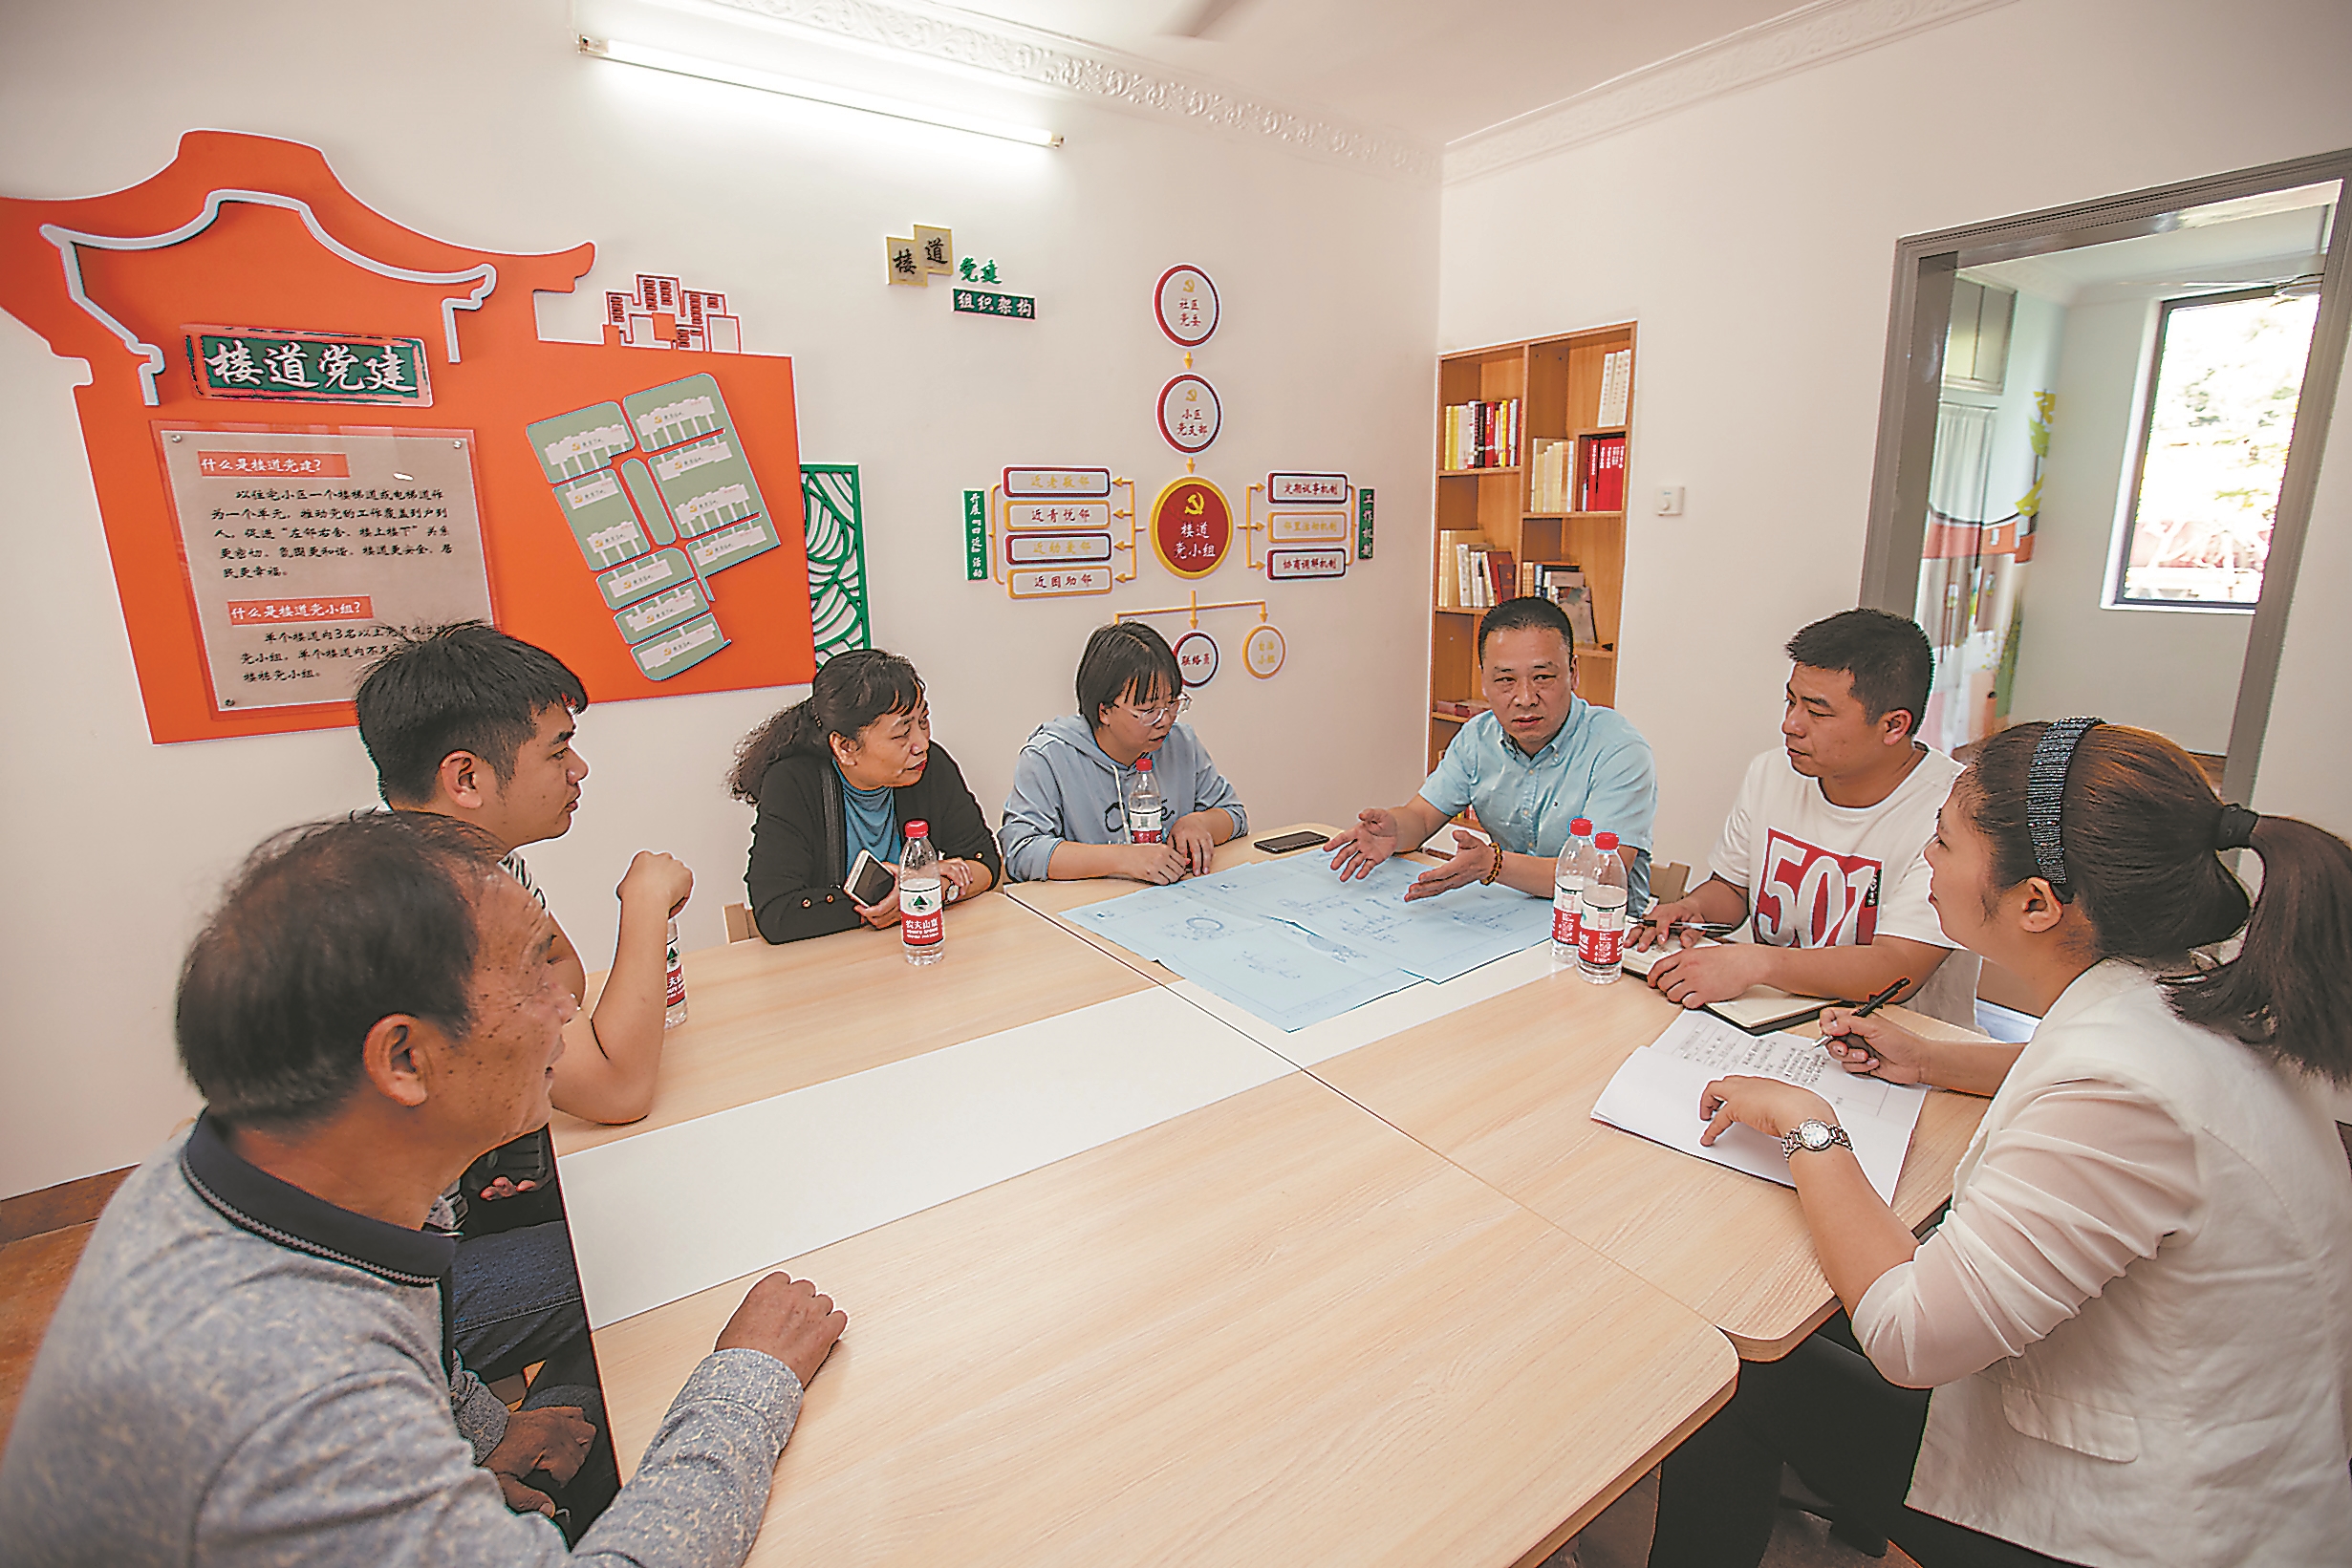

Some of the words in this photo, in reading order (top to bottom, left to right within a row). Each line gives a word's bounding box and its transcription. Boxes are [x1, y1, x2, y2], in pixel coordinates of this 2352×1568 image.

[893, 238, 948, 274] 楼道
[959, 257, 1002, 284] 党建
[958, 291, 1033, 317] 组织架构
[1178, 297, 1200, 311] 社区
[1178, 313, 1201, 327] 党委
[204, 339, 417, 393] 楼道党建
[1181, 408, 1202, 420] 小区
[1176, 422, 1208, 437] 党支部
[1284, 483, 1338, 495] 定期议事机制
[1031, 508, 1091, 523] 近青悦邻
[1180, 521, 1210, 539] 楼道
[1361, 494, 1373, 557] 工作机制
[1174, 542, 1217, 559] 党小组
[1181, 653, 1211, 666] 联络员
[1759, 837, 1876, 948] 501
